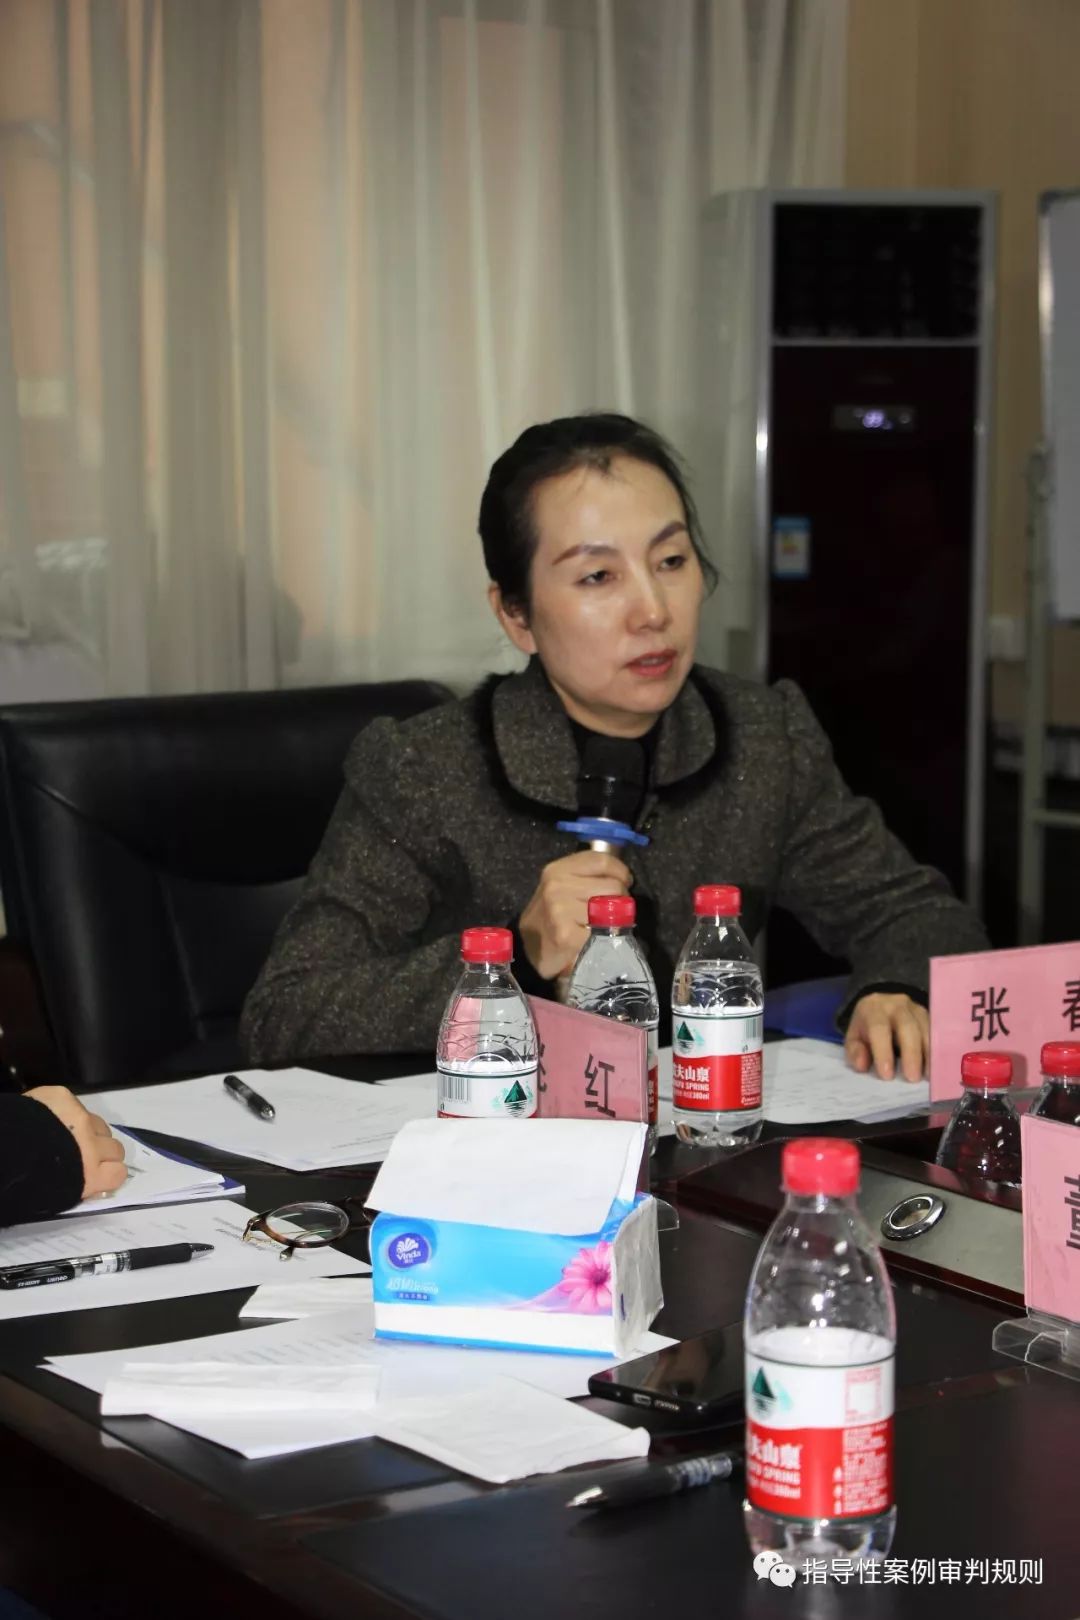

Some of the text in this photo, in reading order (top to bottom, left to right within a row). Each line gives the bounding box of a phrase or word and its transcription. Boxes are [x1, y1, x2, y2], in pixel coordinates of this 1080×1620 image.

[971, 987, 1010, 1042] 张
[584, 1053, 616, 1118] 红
[673, 1062, 711, 1082] 夫山泉
[396, 1250, 421, 1260] Vinda
